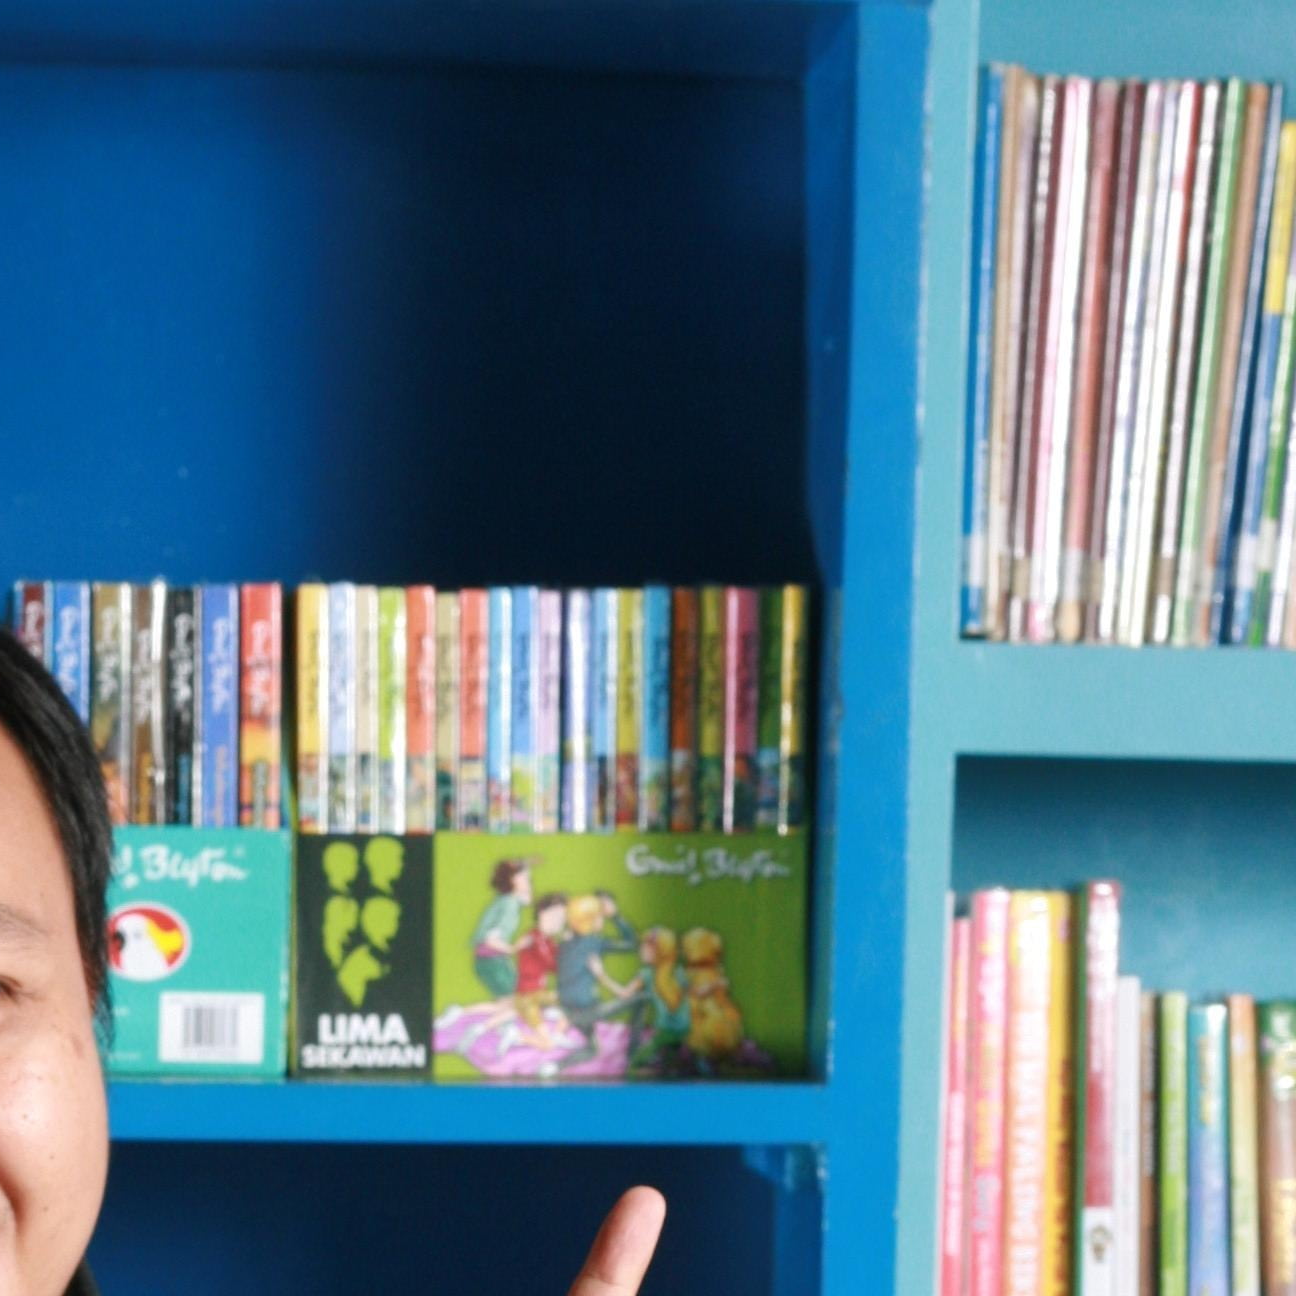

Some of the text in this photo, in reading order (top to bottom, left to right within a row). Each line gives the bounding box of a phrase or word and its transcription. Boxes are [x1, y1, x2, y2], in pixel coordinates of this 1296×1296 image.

[140, 845, 248, 887] Blyton
[318, 1013, 409, 1044] LIMA
[303, 1046, 426, 1068] SEKAWAN
